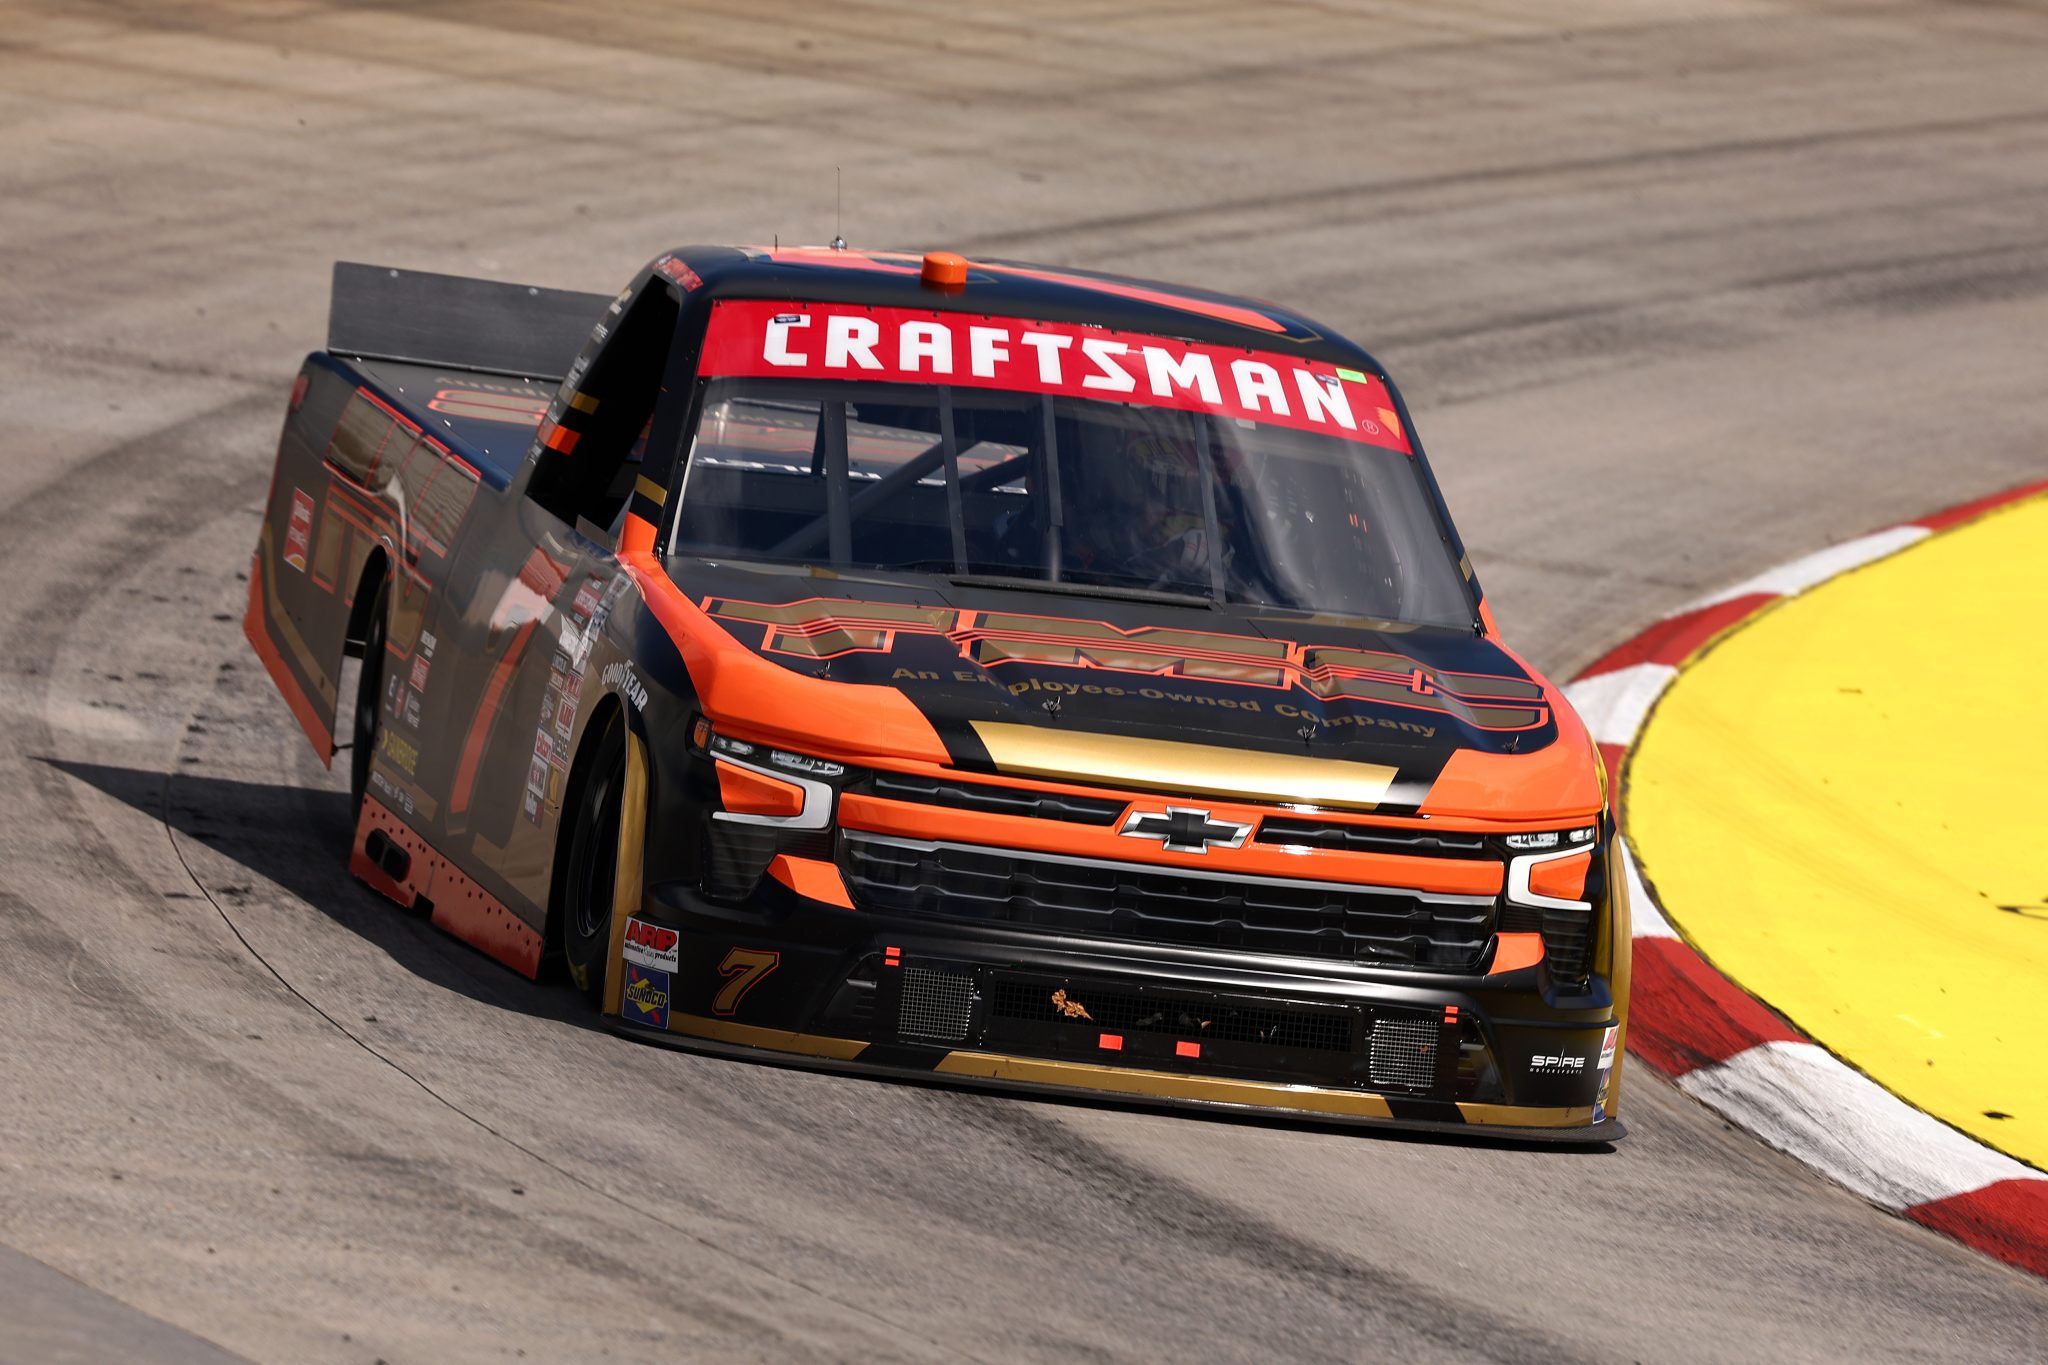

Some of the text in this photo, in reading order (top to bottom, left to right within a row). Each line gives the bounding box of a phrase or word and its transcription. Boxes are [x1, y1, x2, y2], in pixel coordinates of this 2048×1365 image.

[763, 313, 1357, 430] CRAFTSMAN
[602, 663, 648, 712] GOODYEAR
[891, 667, 1436, 737] An Employee-Owned Company
[625, 919, 677, 952] ARP
[654, 951, 677, 963] products
[628, 986, 666, 1008] SUNOCO
[711, 946, 780, 1015] 7
[1531, 1048, 1585, 1068] SPIRE
